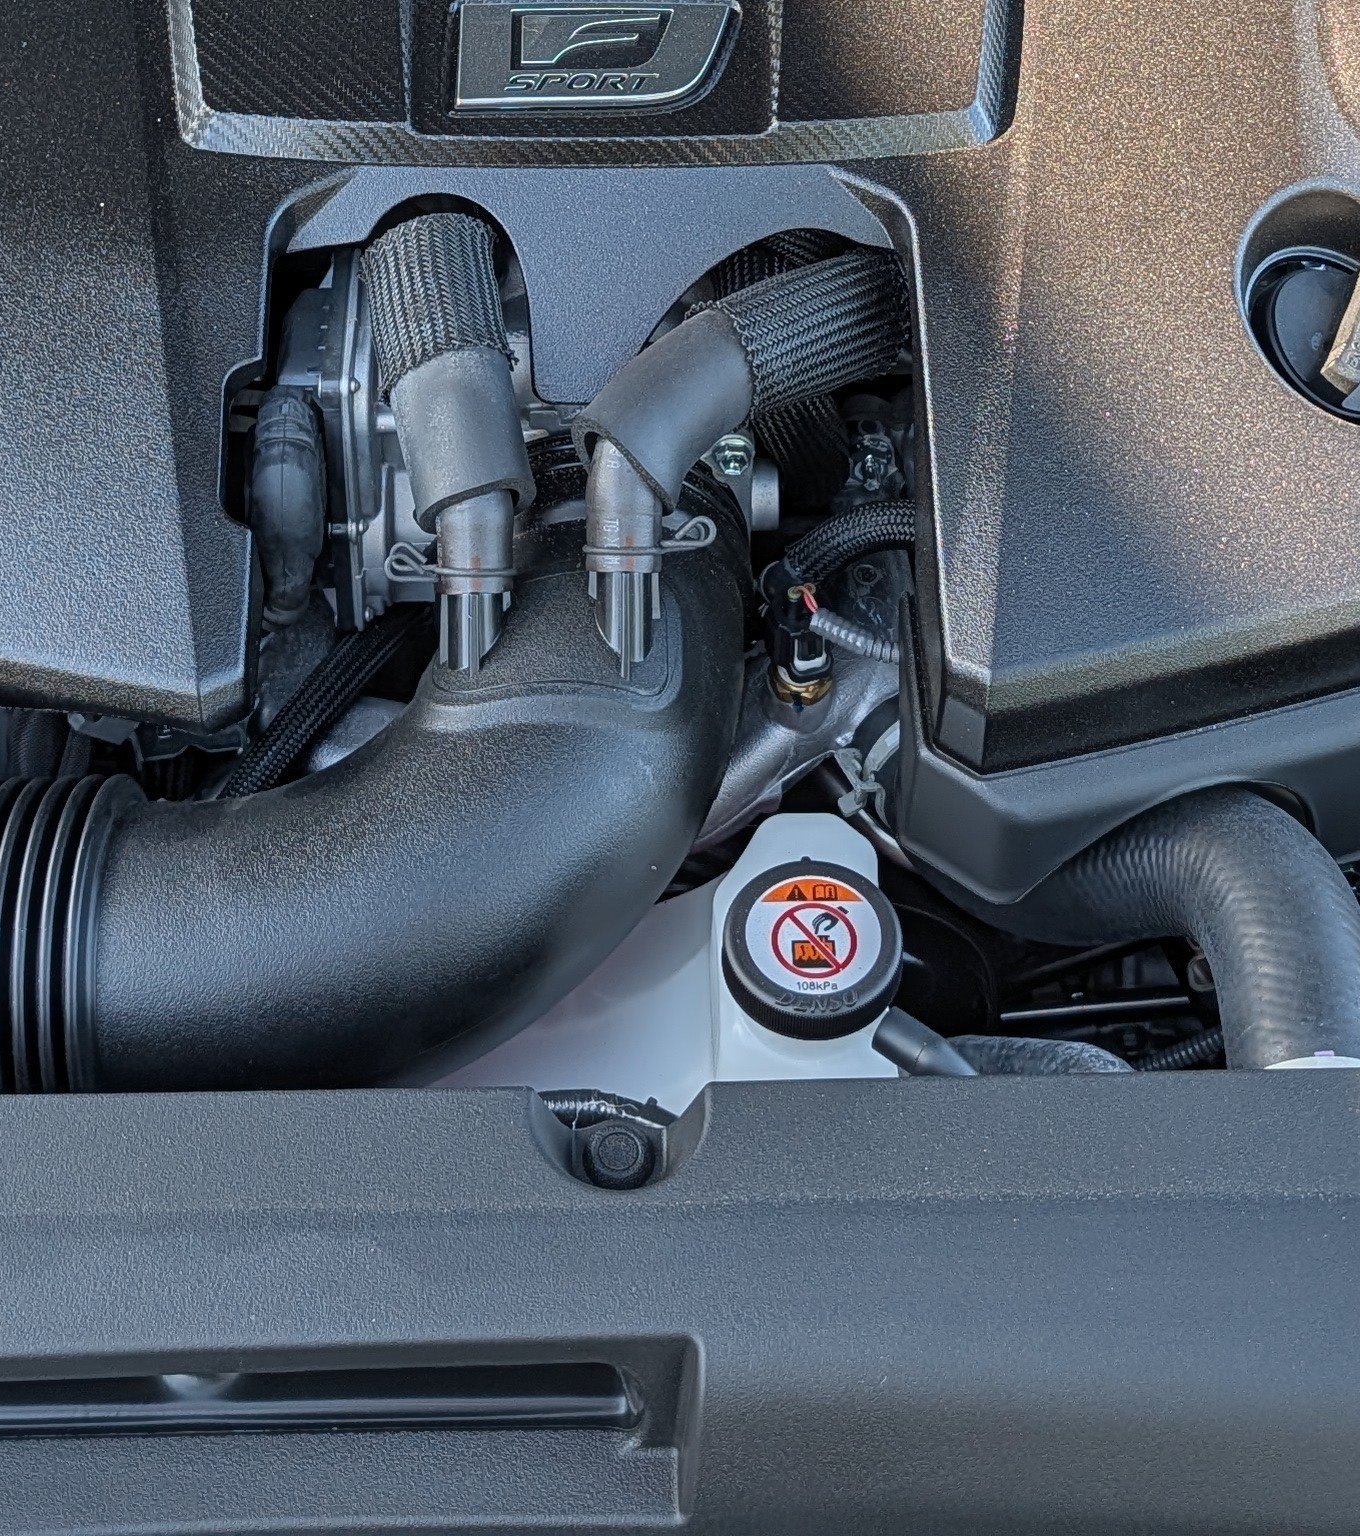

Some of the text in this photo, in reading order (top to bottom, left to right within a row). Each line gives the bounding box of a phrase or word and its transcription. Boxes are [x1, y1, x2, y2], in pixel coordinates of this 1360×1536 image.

[504, 73, 660, 91] SPORT
[796, 980, 839, 992] 108kPa
[774, 989, 861, 1014] DENSO
